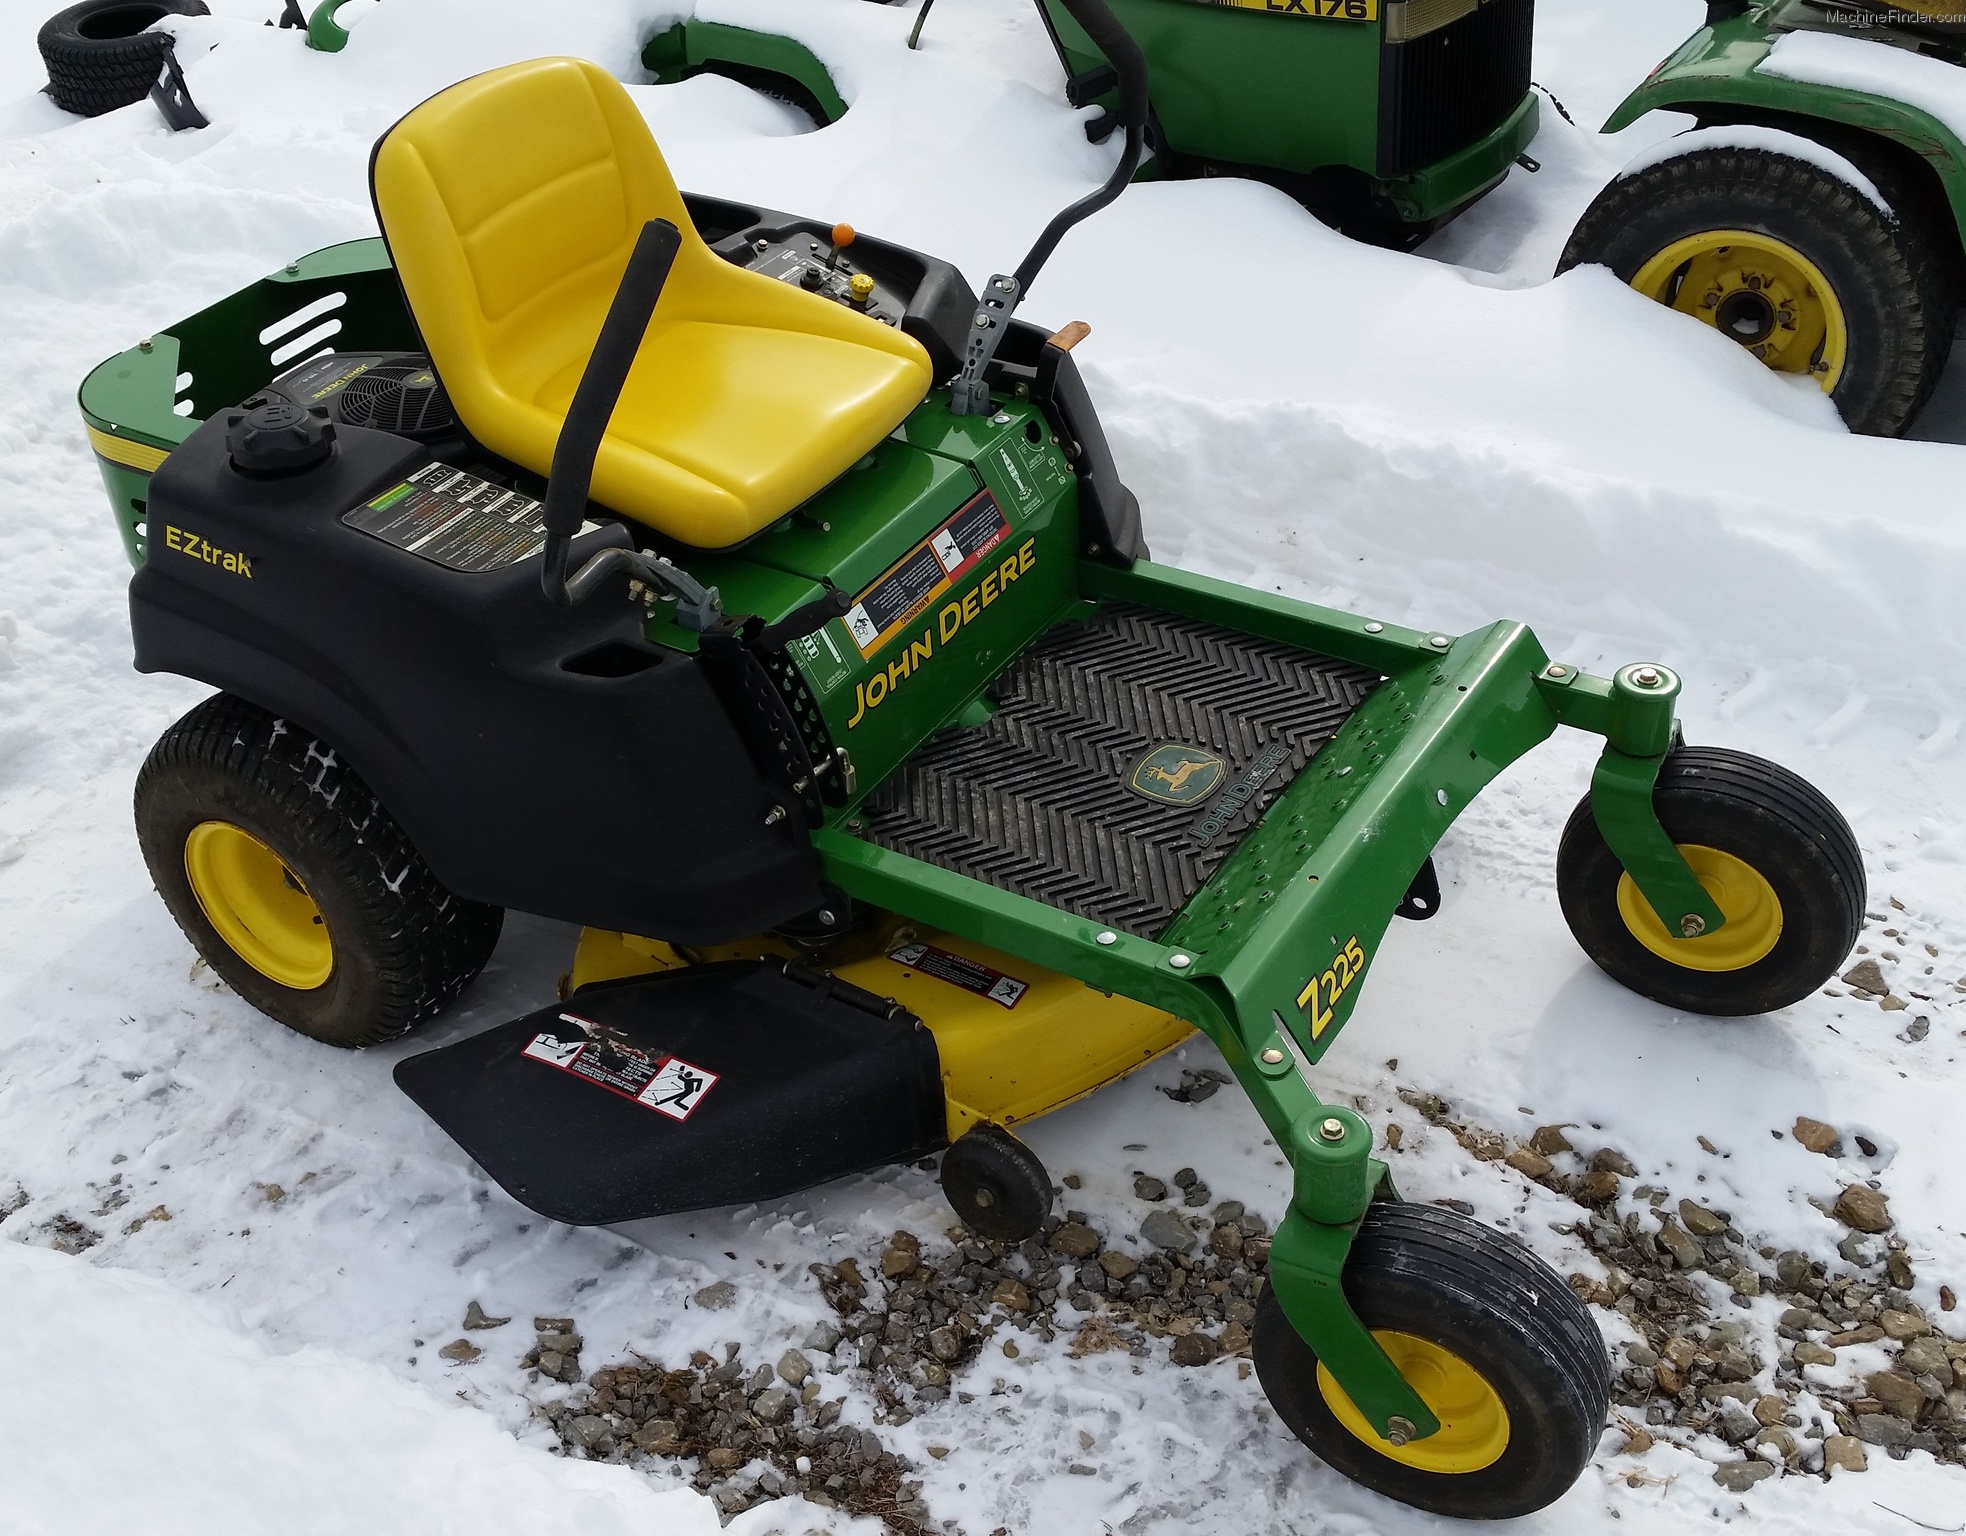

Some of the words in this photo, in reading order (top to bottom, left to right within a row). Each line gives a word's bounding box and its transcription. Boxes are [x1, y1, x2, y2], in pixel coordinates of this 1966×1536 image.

[1266, 0, 1368, 18] LX176
[311, 379, 346, 400] DEERE
[165, 525, 252, 579] EZtrak
[974, 536, 996, 559] DANGER
[898, 598, 926, 625] WARNING
[848, 628, 934, 731] JOHN
[938, 537, 1037, 647] DEERE
[1188, 794, 1241, 848] JOHN
[1229, 744, 1292, 804] DEERE
[953, 956, 987, 972] DANGER
[1296, 935, 1366, 1043] Z225
